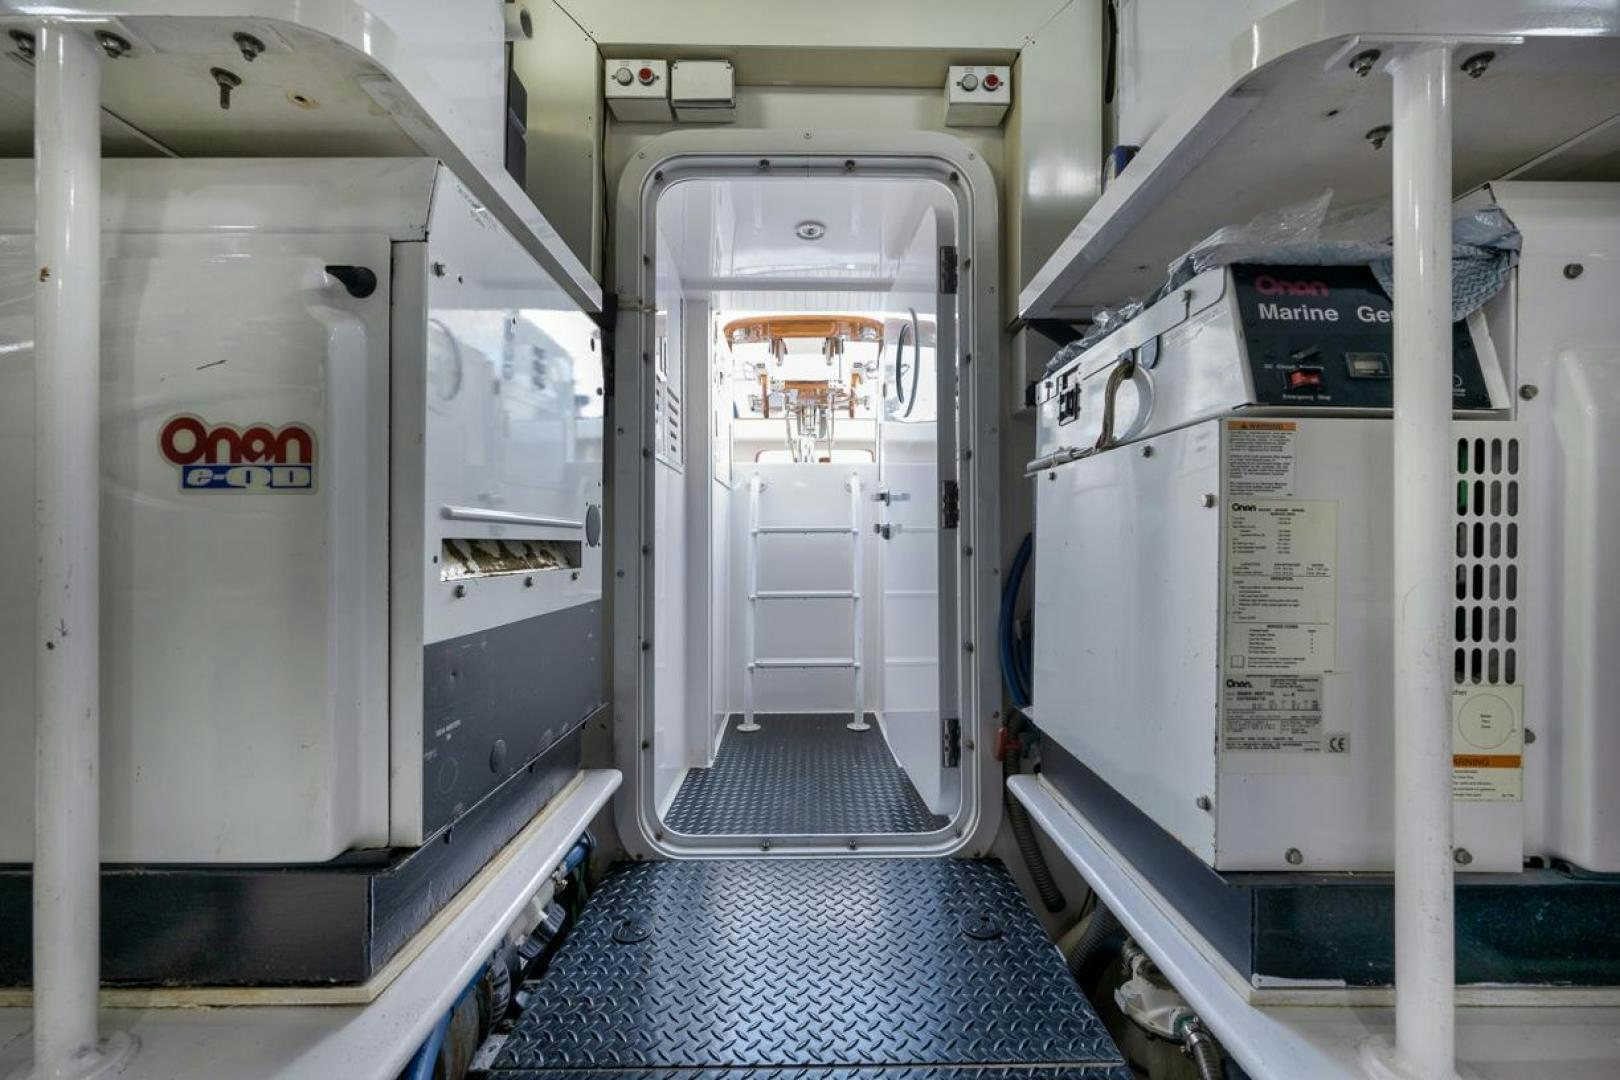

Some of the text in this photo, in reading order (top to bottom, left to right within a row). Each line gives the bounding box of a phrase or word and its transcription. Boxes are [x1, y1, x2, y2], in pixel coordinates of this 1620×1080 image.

[1256, 275, 1329, 297] Onan
[1258, 303, 1394, 323] Marine Ge
[161, 417, 312, 465] Onan
[187, 466, 311, 490] e-QD
[1453, 757, 1490, 768] ARNING
